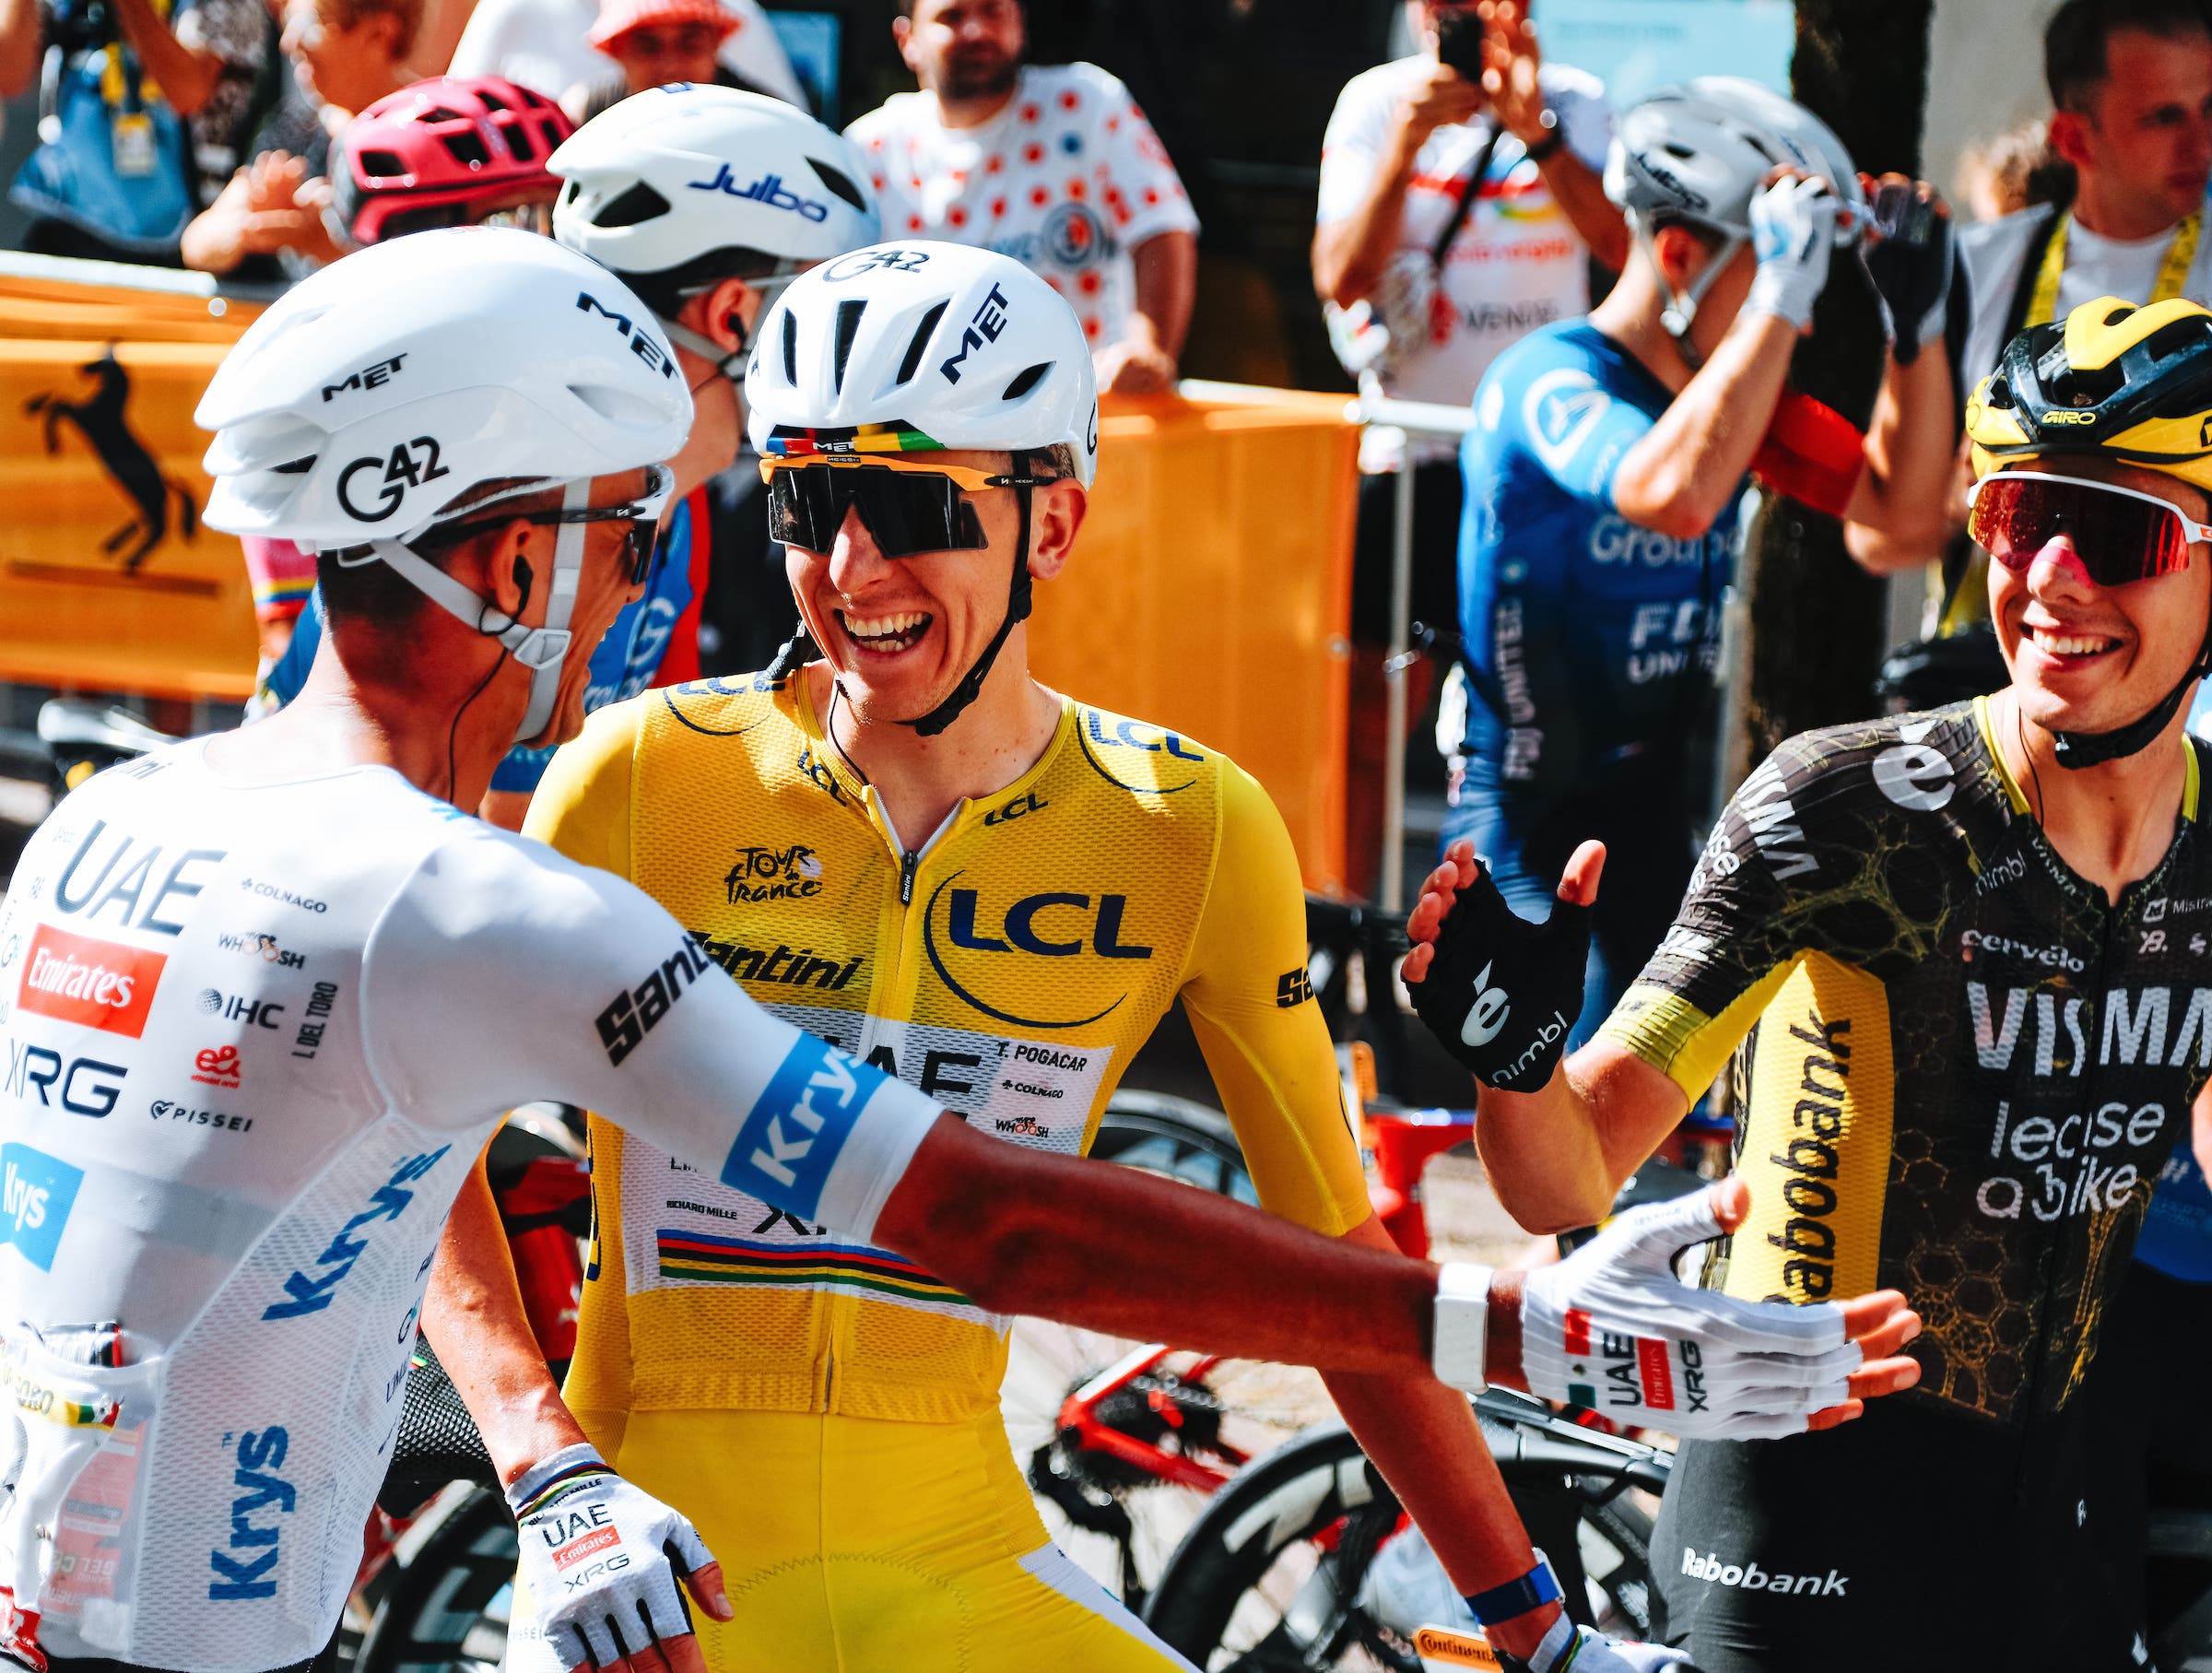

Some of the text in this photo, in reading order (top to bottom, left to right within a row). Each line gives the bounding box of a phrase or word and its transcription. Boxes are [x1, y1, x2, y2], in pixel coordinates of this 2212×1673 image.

[686, 162, 828, 223] Julbo
[822, 250, 931, 283] G42
[576, 290, 680, 380] MET
[939, 281, 1009, 385] MET
[322, 352, 408, 402] MET
[2041, 410, 2097, 426] GIRO
[812, 441, 858, 453] MET
[336, 435, 451, 523] G42
[1087, 710, 1205, 762] LCL
[797, 748, 847, 807] LCL
[984, 794, 1049, 827] LCL
[55, 819, 229, 937] UAE
[254, 882, 328, 913] COLNAGO
[950, 889, 1153, 960] LCL
[28, 947, 135, 1008] Emirates
[687, 930, 865, 991] antini
[224, 996, 285, 1031] IHC
[305, 982, 338, 1019] TORO
[296, 1023, 325, 1048] DEL
[1015, 1044, 1088, 1072] POGACAR
[1490, 1010, 1568, 1084] nimbl
[4, 1038, 129, 1119] XRG
[1016, 1082, 1065, 1099] COLNAGO
[172, 1108, 253, 1133] PISSEI
[1761, 1009, 1852, 1304] abobank
[3, 1161, 50, 1232] Krys
[666, 1199, 737, 1220] RICHARD MILLE
[1977, 1176, 2024, 1219] a
[1602, 1333, 1642, 1407] UAE
[1680, 1340, 1710, 1414] XRG
[208, 1425, 297, 1600] Krys
[542, 1503, 613, 1548] UAE
[559, 1532, 614, 1564] Emirates
[1680, 1547, 1851, 1597] Rabobank
[564, 1553, 630, 1594] XRG
